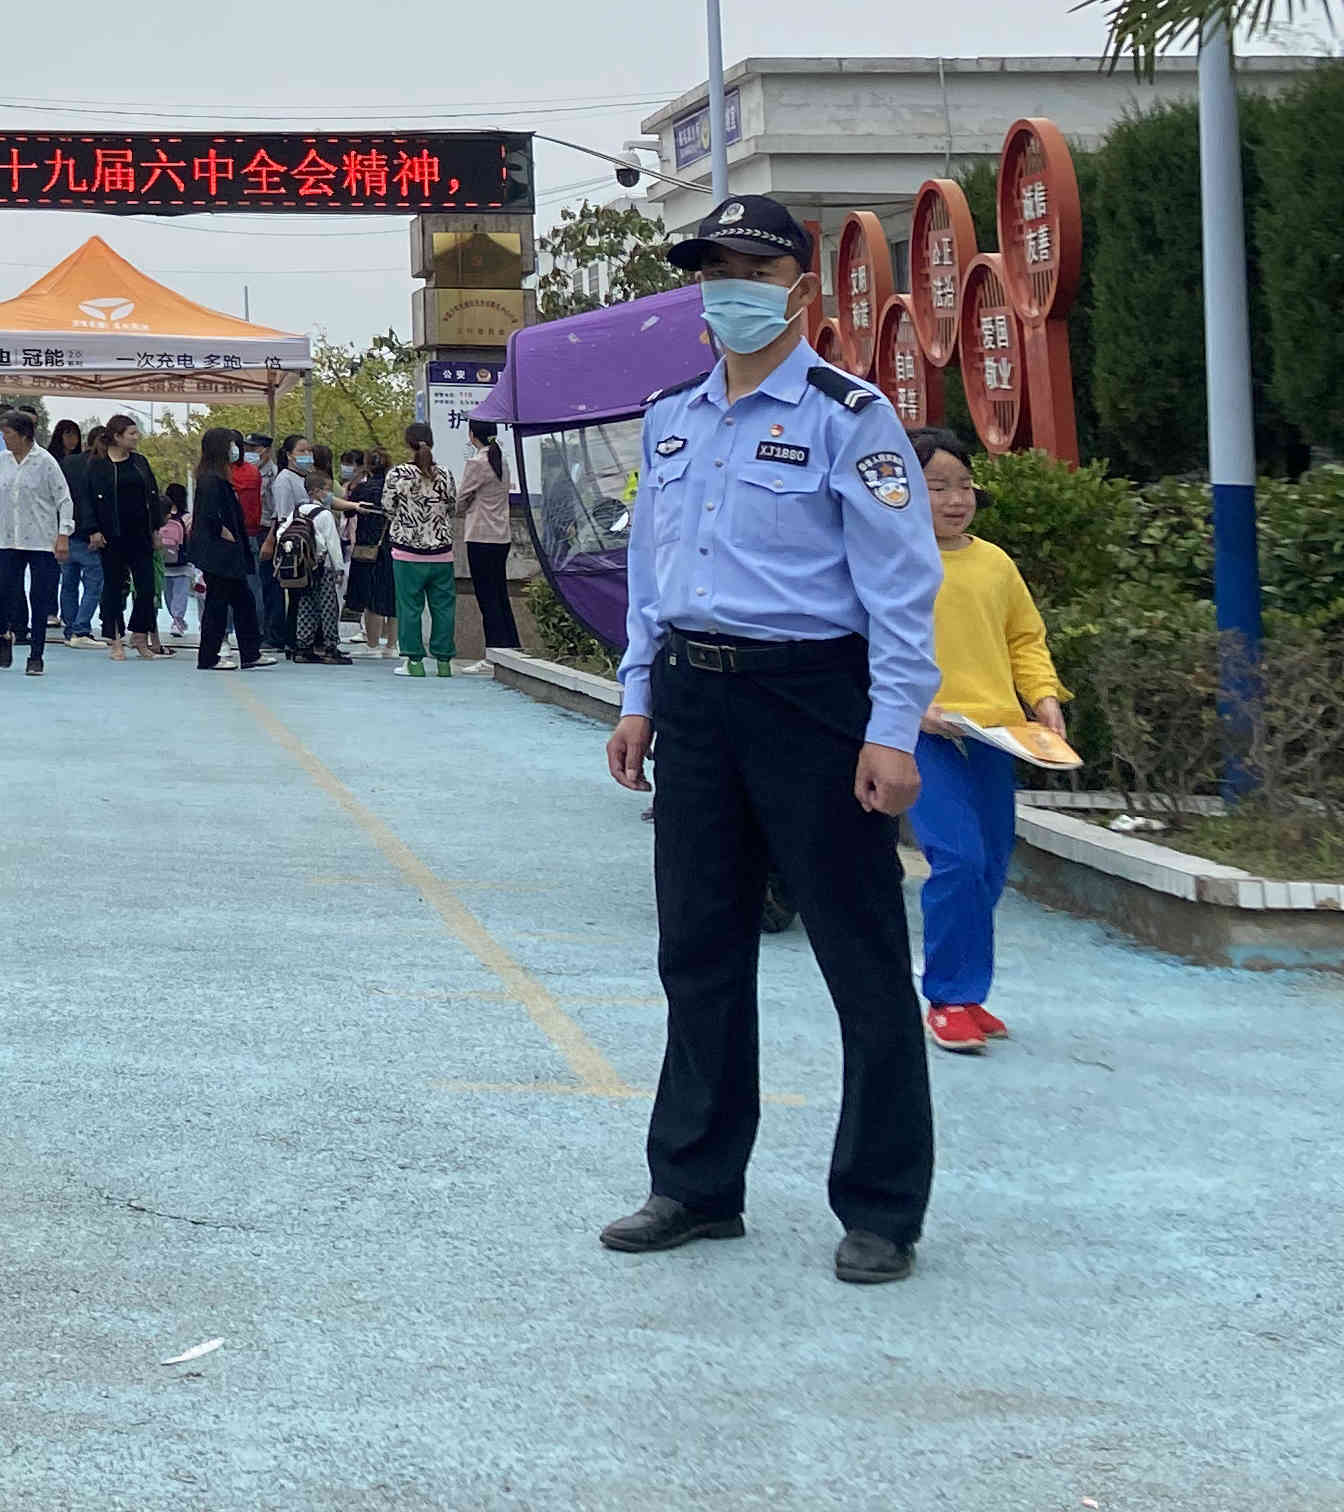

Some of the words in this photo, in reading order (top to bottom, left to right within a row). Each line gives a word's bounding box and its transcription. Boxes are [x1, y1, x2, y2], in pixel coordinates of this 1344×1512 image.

[22, 348, 65, 367] 冠能
[116, 352, 195, 369] 一次充电
[203, 353, 282, 370] 多跑一倍
